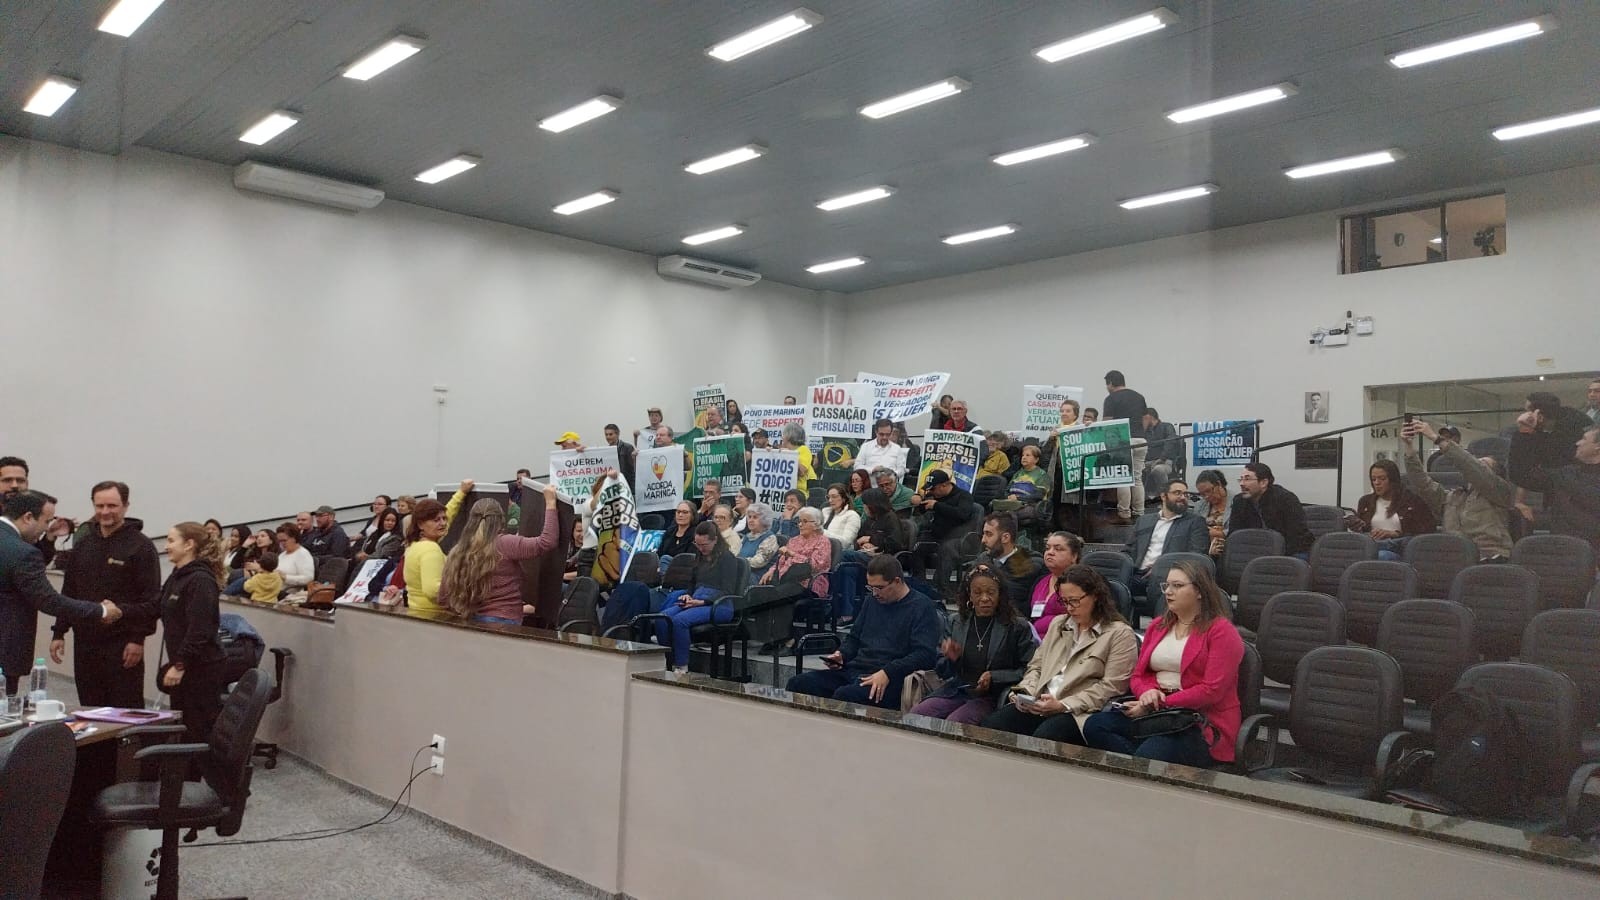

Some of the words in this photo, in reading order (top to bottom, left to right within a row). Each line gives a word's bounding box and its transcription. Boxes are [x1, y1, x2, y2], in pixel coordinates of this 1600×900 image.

[813, 385, 845, 405] NÃO
[1035, 393, 1069, 401] QUEREM
[1027, 401, 1056, 409] CASSAR
[812, 406, 867, 423] CASSAÇÃO
[811, 421, 865, 434] #CRISLAUER
[933, 433, 974, 445] PATRIOTA
[1063, 432, 1081, 447] SOU
[1198, 434, 1243, 450] CASSAÇÃO
[696, 443, 711, 455] SOU
[926, 443, 934, 453] O
[936, 443, 976, 459] BRASIL
[1065, 442, 1107, 457] PATRIOTA
[1198, 446, 1253, 459] #CRISLAUER
[565, 458, 603, 467] QUEREM
[697, 453, 729, 465] PATRIOTA
[960, 456, 976, 466] DE
[556, 467, 592, 478] CASSAR
[697, 465, 712, 477] SOU
[755, 459, 795, 475] SOMOS
[1068, 467, 1090, 483] CRS
[1092, 464, 1130, 479] LAUER
[646, 480, 673, 492] ACORDA
[755, 474, 792, 490] TODOS
